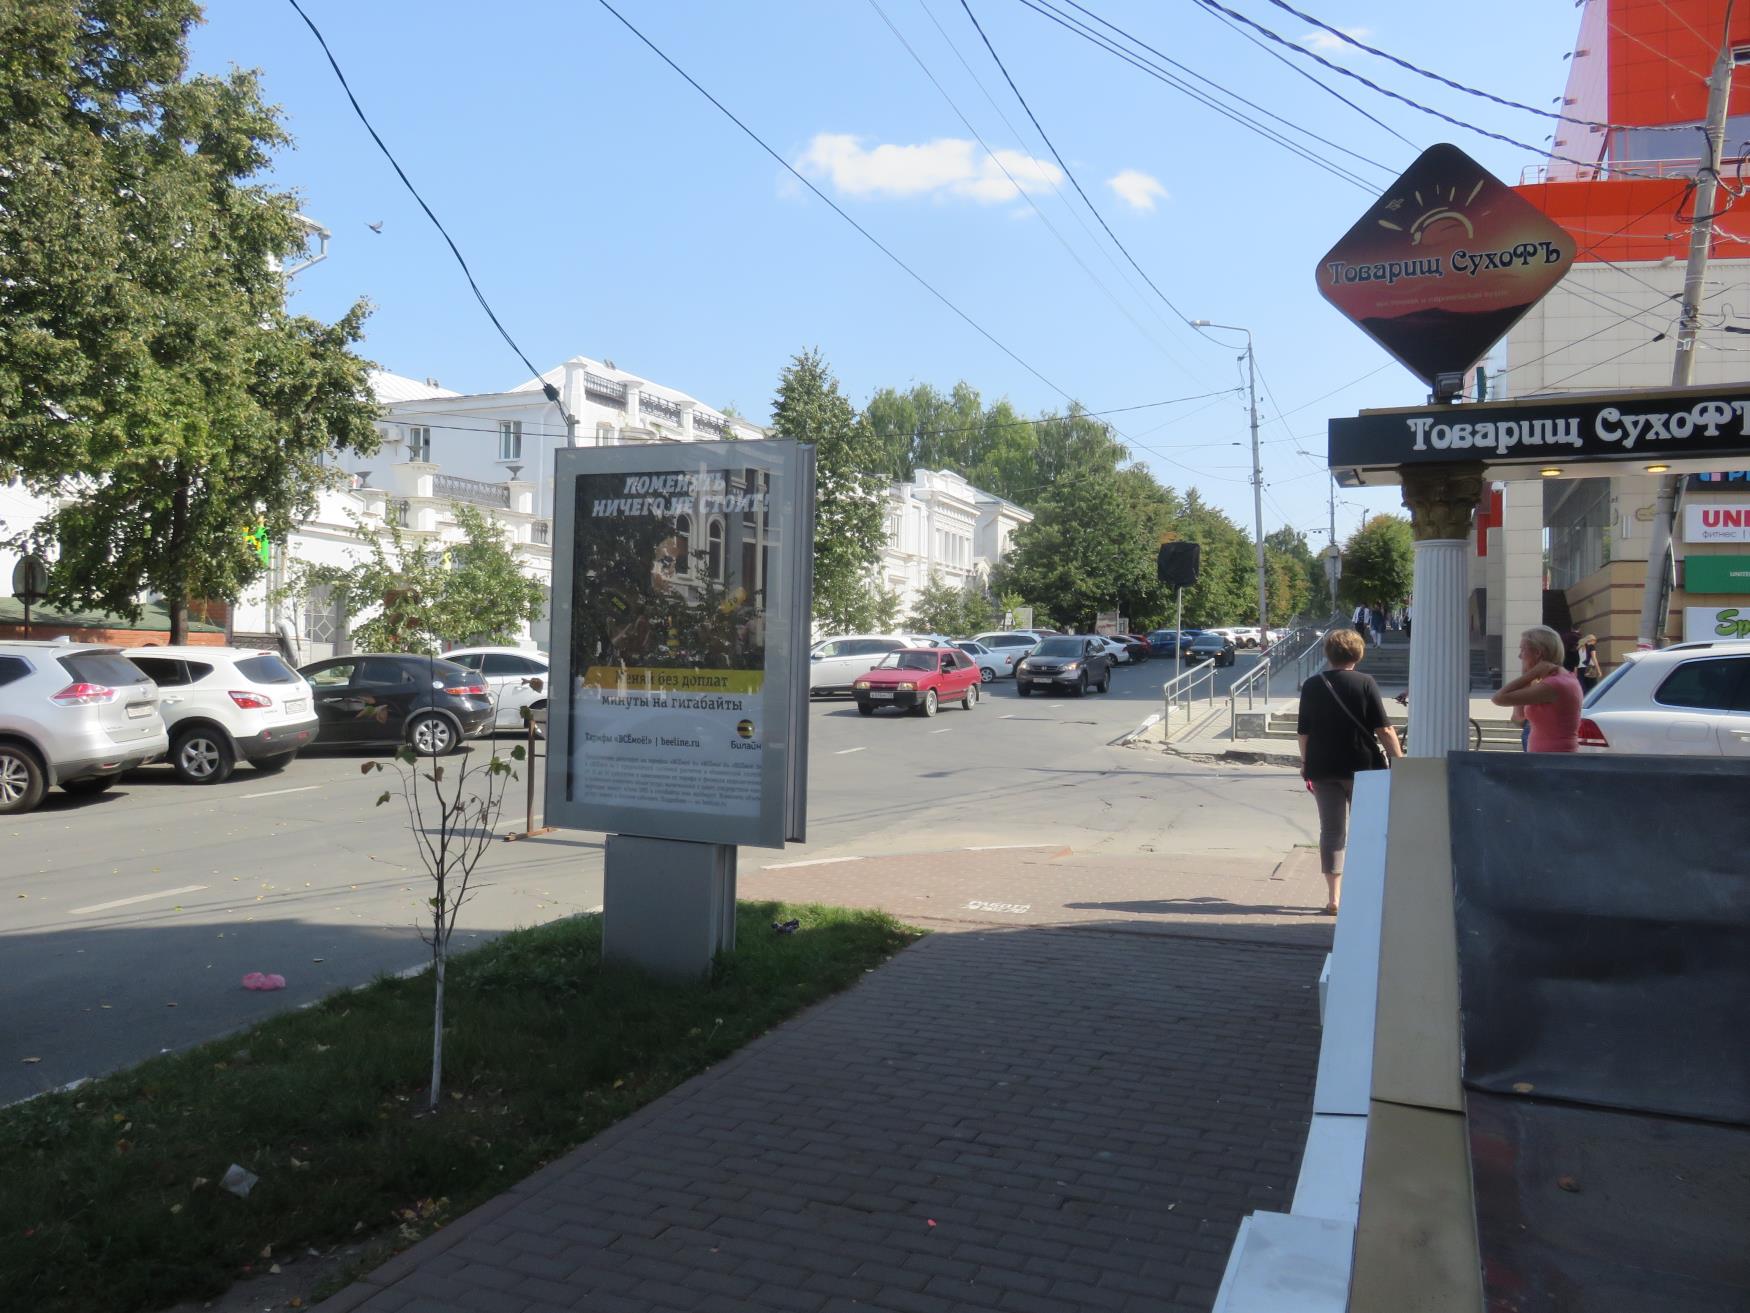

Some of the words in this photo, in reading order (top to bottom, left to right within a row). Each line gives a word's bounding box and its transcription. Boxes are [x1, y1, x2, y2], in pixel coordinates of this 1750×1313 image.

[1329, 256, 1443, 284] Товарищ
[1406, 417, 1584, 454] Товарищ
[592, 497, 665, 517] НИЧЕГО
[669, 496, 695, 515] НЕ
[657, 671, 679, 686] без
[682, 674, 729, 688] доплат
[601, 695, 649, 710] минуты
[652, 697, 668, 708] на
[671, 696, 743, 711] гигабайты
[660, 738, 701, 748] beeline.ru
[730, 740, 762, 750] Билайн
